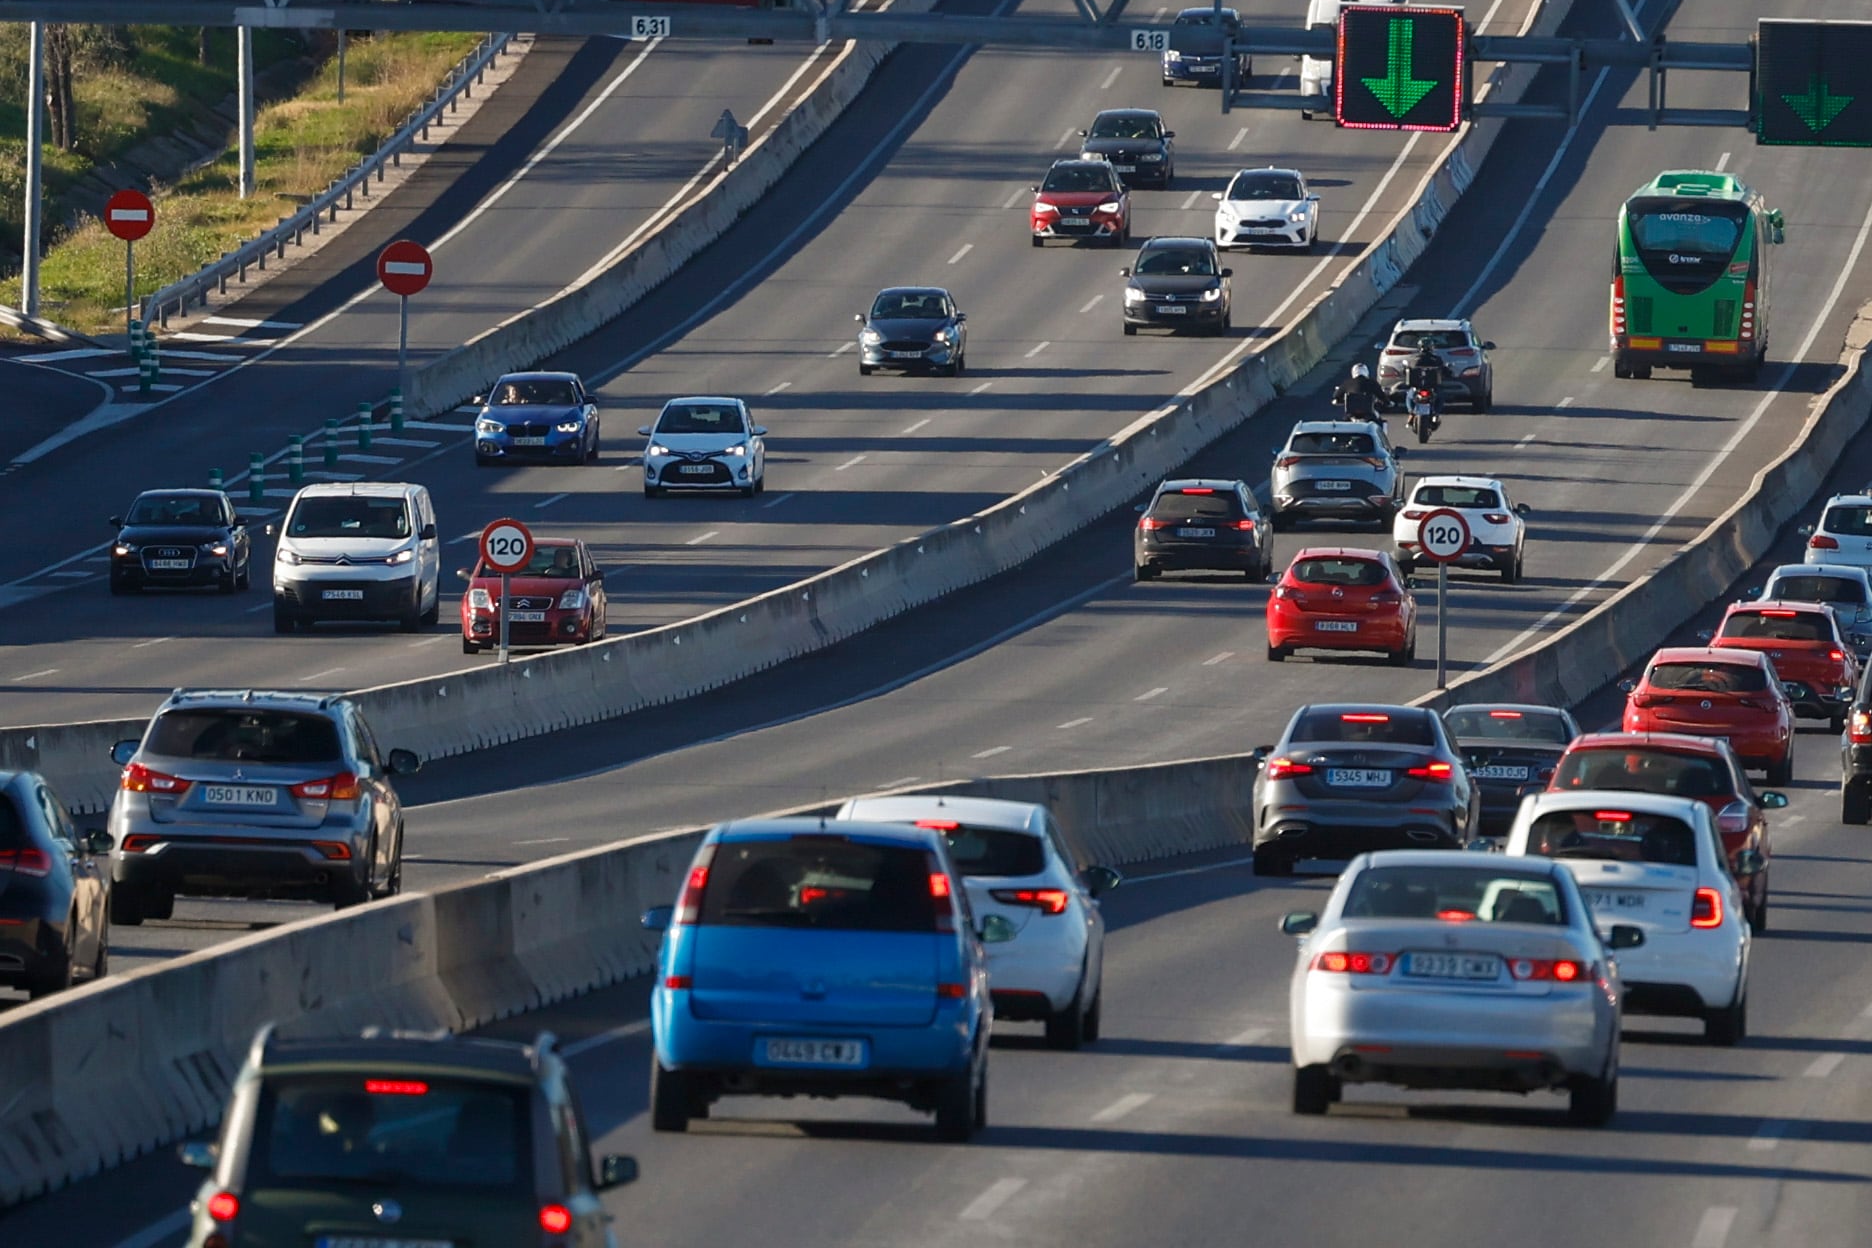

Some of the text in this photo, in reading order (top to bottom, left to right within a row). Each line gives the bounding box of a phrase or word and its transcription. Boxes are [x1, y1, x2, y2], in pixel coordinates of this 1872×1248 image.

[637, 19, 665, 35] 6,31
[1136, 33, 1164, 50] 6,18
[1660, 213, 1700, 221] avanza
[1428, 527, 1460, 544] 120
[489, 538, 524, 556] 120
[1335, 771, 1387, 783] 5345 MHJ
[209, 787, 273, 803] 0501 KND
